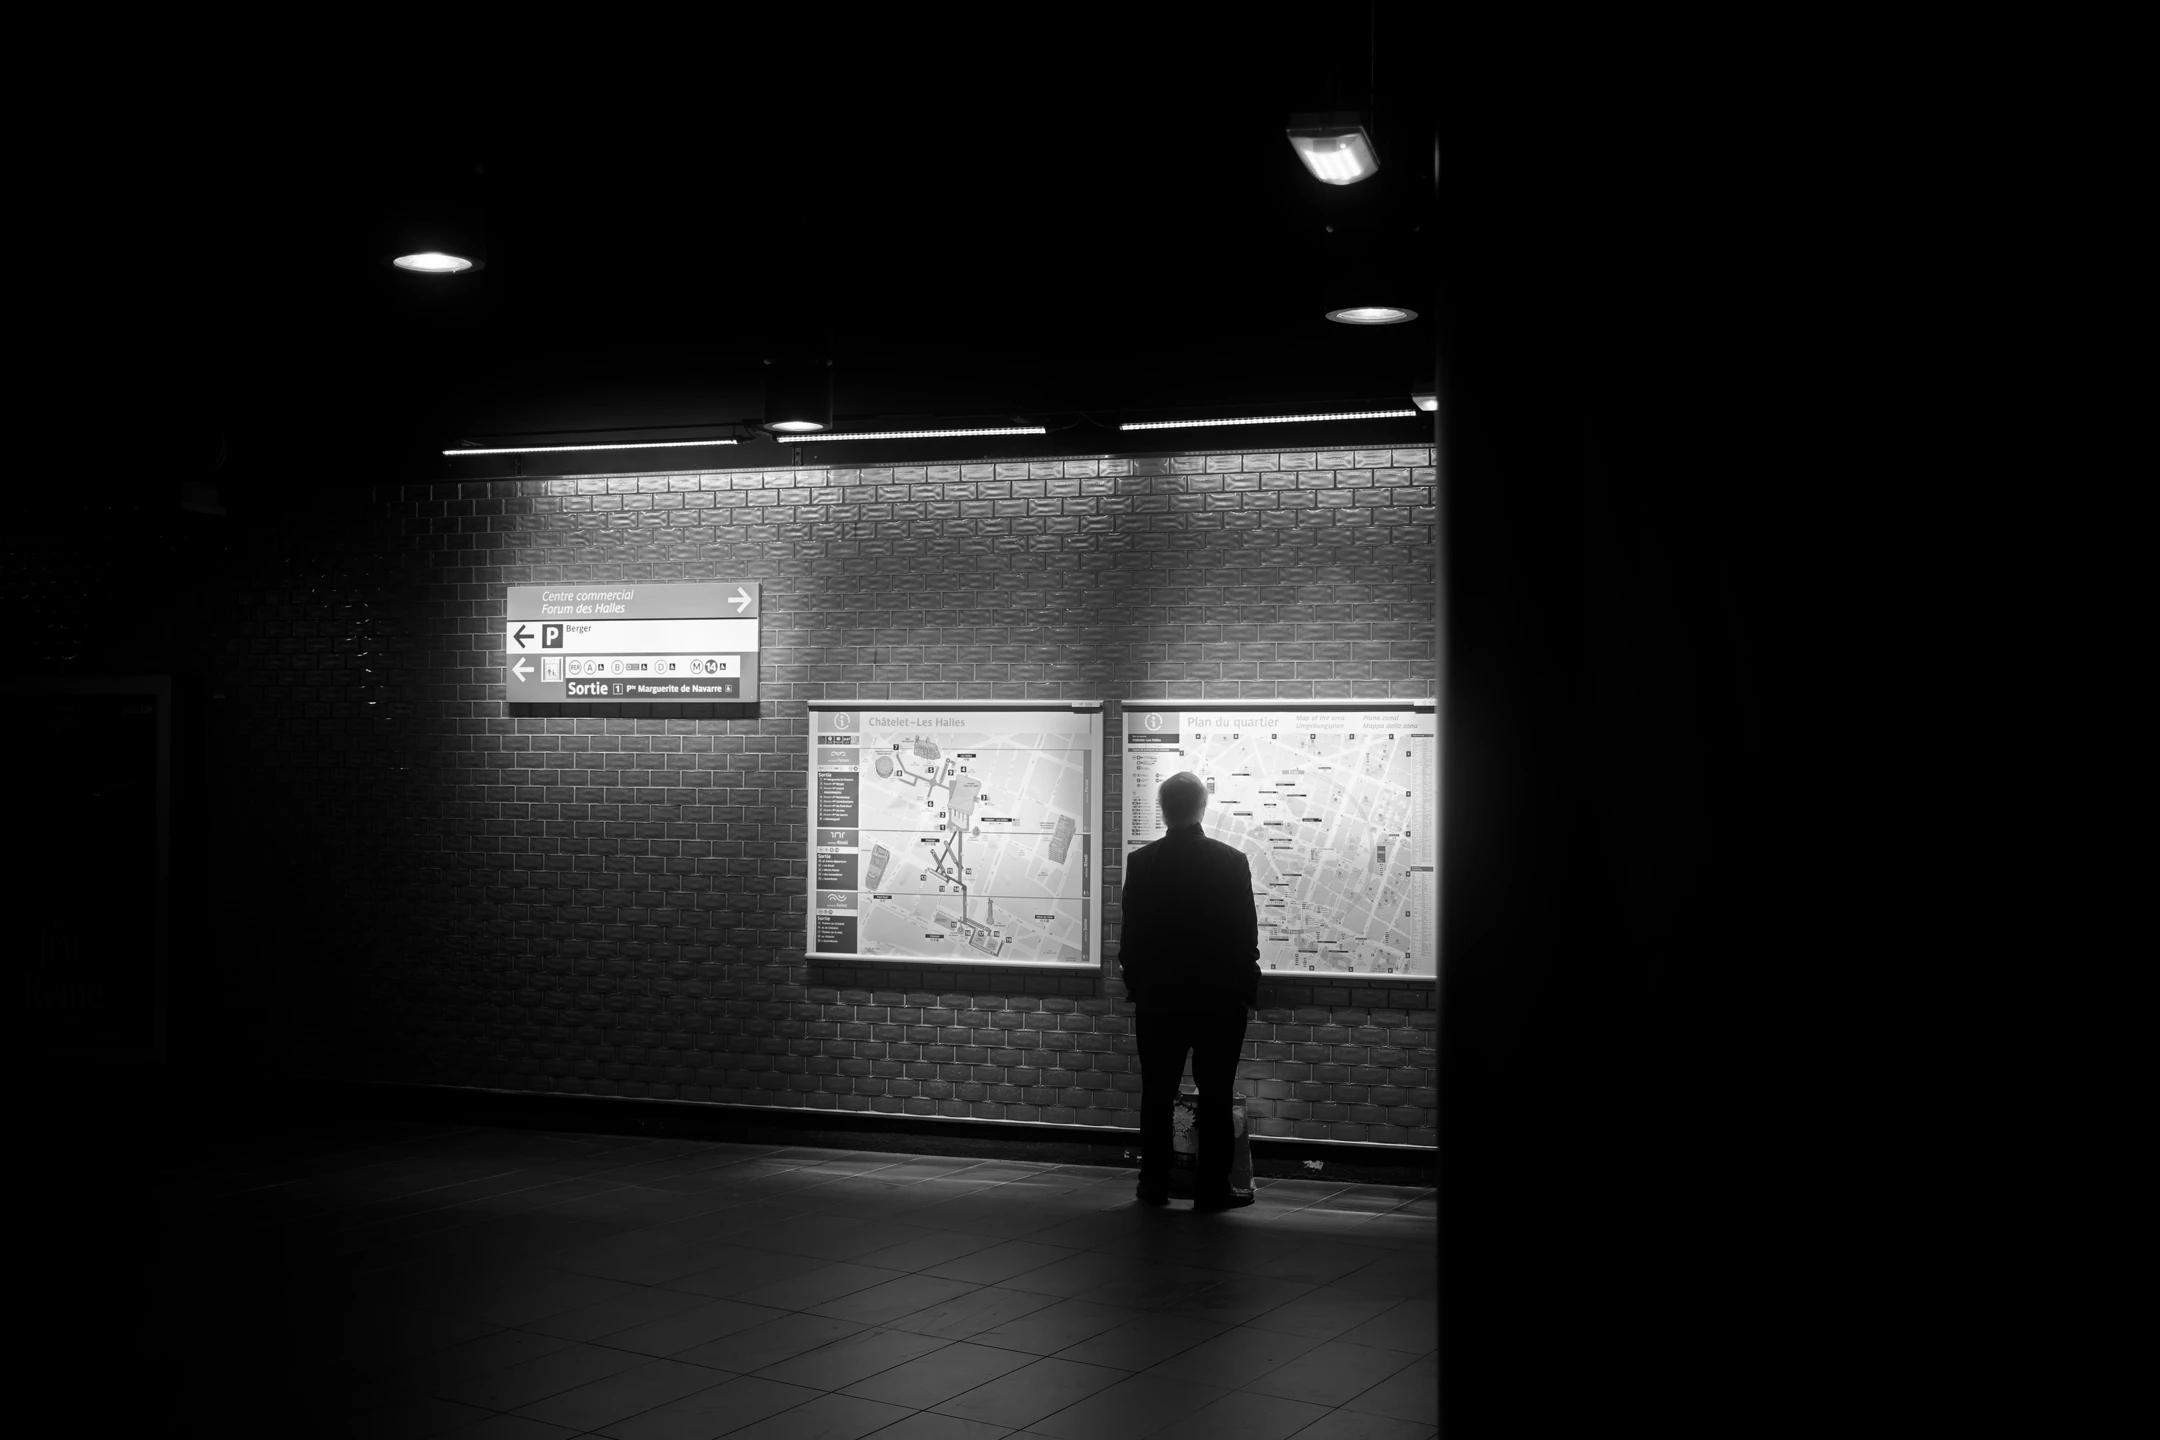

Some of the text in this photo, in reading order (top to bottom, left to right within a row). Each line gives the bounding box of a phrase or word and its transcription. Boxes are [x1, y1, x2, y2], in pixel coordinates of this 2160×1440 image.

[542, 589, 634, 601] Centre commercial
[541, 602, 626, 614] Forum des Halles
[566, 625, 592, 634] Berger
[546, 626, 559, 646] P
[706, 662, 717, 672] 14
[568, 681, 608, 695] Sortie
[638, 684, 680, 695] Marguerite
[680, 684, 690, 693] de
[691, 684, 722, 693] Navarre
[935, 717, 966, 727] Halles
[1187, 716, 1279, 729] Plan du quartier
